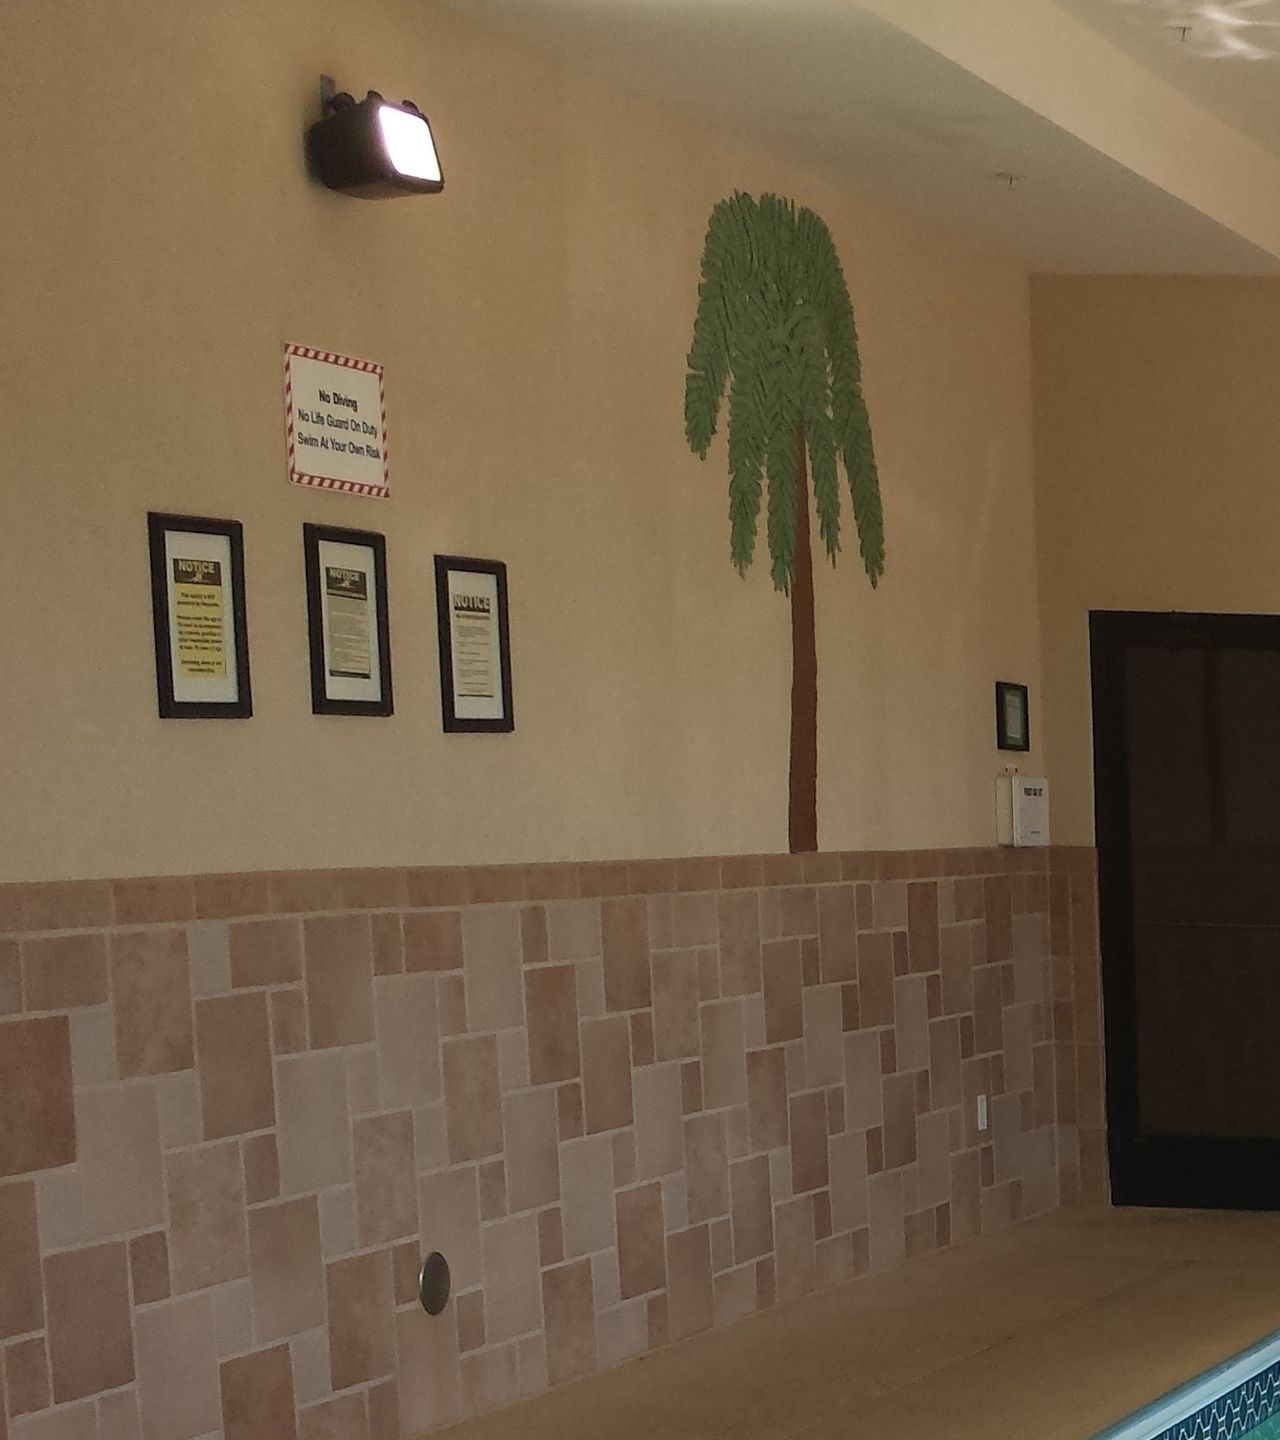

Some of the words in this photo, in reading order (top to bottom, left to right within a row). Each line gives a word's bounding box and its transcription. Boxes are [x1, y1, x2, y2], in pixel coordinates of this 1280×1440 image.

[319, 389, 330, 403] No
[333, 393, 357, 412] Diving
[298, 409, 309, 421] No
[311, 412, 325, 425] Life
[327, 414, 349, 430] Guard
[351, 420, 361, 432] On
[362, 422, 377, 439] Duty
[298, 432, 318, 447] Swim
[320, 437, 328, 448] At
[330, 438, 347, 452] Your
[350, 442, 364, 456] Own
[366, 445, 380, 459] Risk
[178, 559, 216, 574] NOTICE
[453, 594, 490, 609] NOTICE
